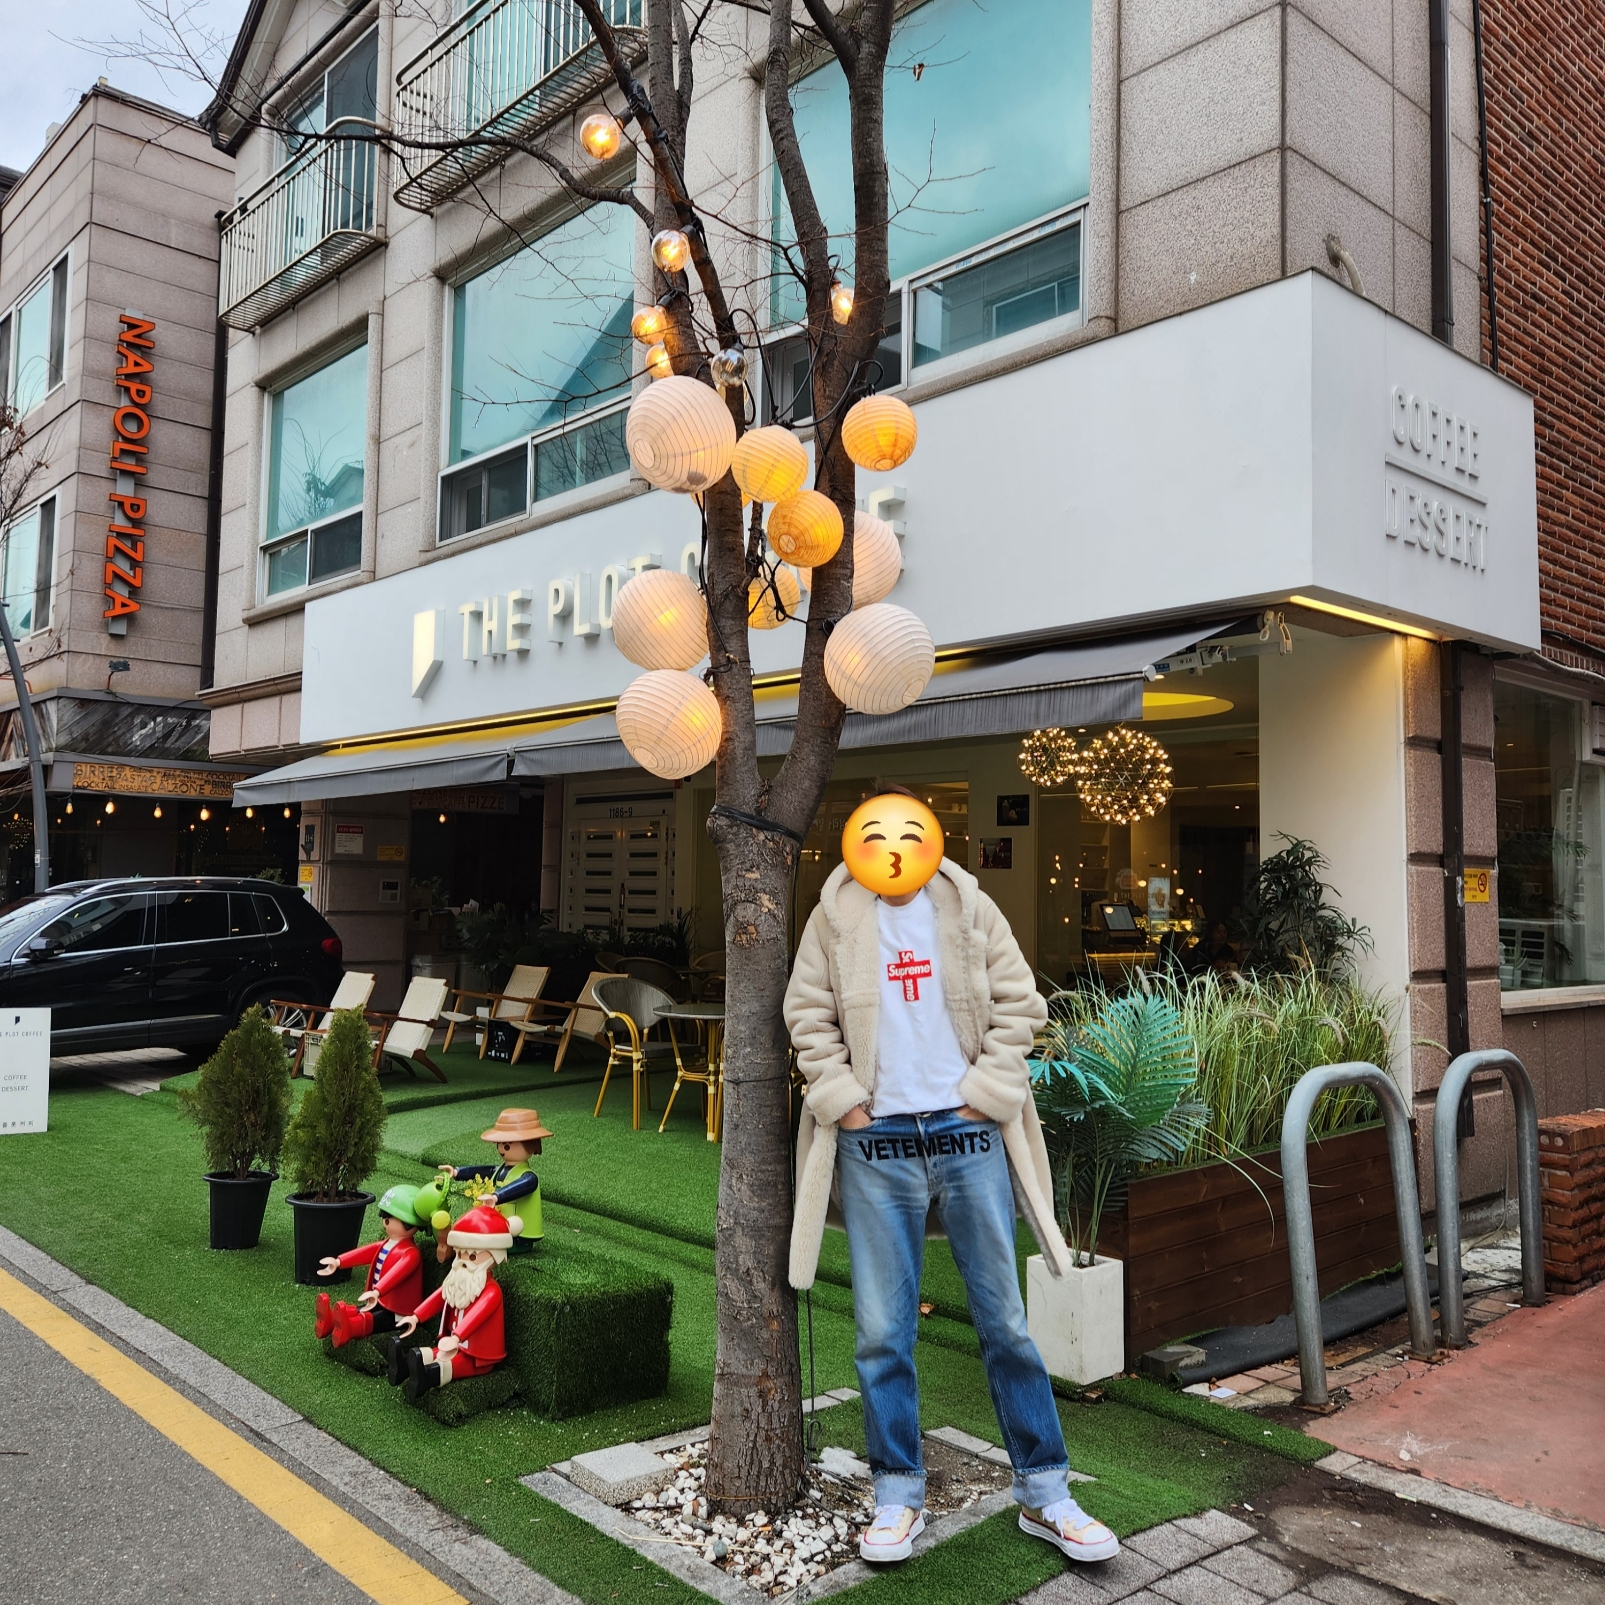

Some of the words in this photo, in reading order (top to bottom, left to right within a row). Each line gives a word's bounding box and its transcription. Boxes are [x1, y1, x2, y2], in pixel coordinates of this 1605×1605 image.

[109, 313, 156, 475] NAPOLI
[1391, 385, 1480, 480] COFFEE
[1384, 478, 1489, 574] DESSERT
[103, 492, 148, 619] PIZZA
[458, 588, 533, 662] THE
[75, 763, 117, 778] BIRRE
[116, 772, 148, 784] PASTA
[206, 772, 242, 782] COCKTAIL
[76, 780, 117, 790] COCKTAIL
[151, 781, 205, 795] CALZONE
[467, 795, 505, 810] PIZZE
[608, 806, 633, 819] 1186-9
[888, 964, 931, 980] Supreme
[857, 1130, 991, 1162] VETEMENTS
